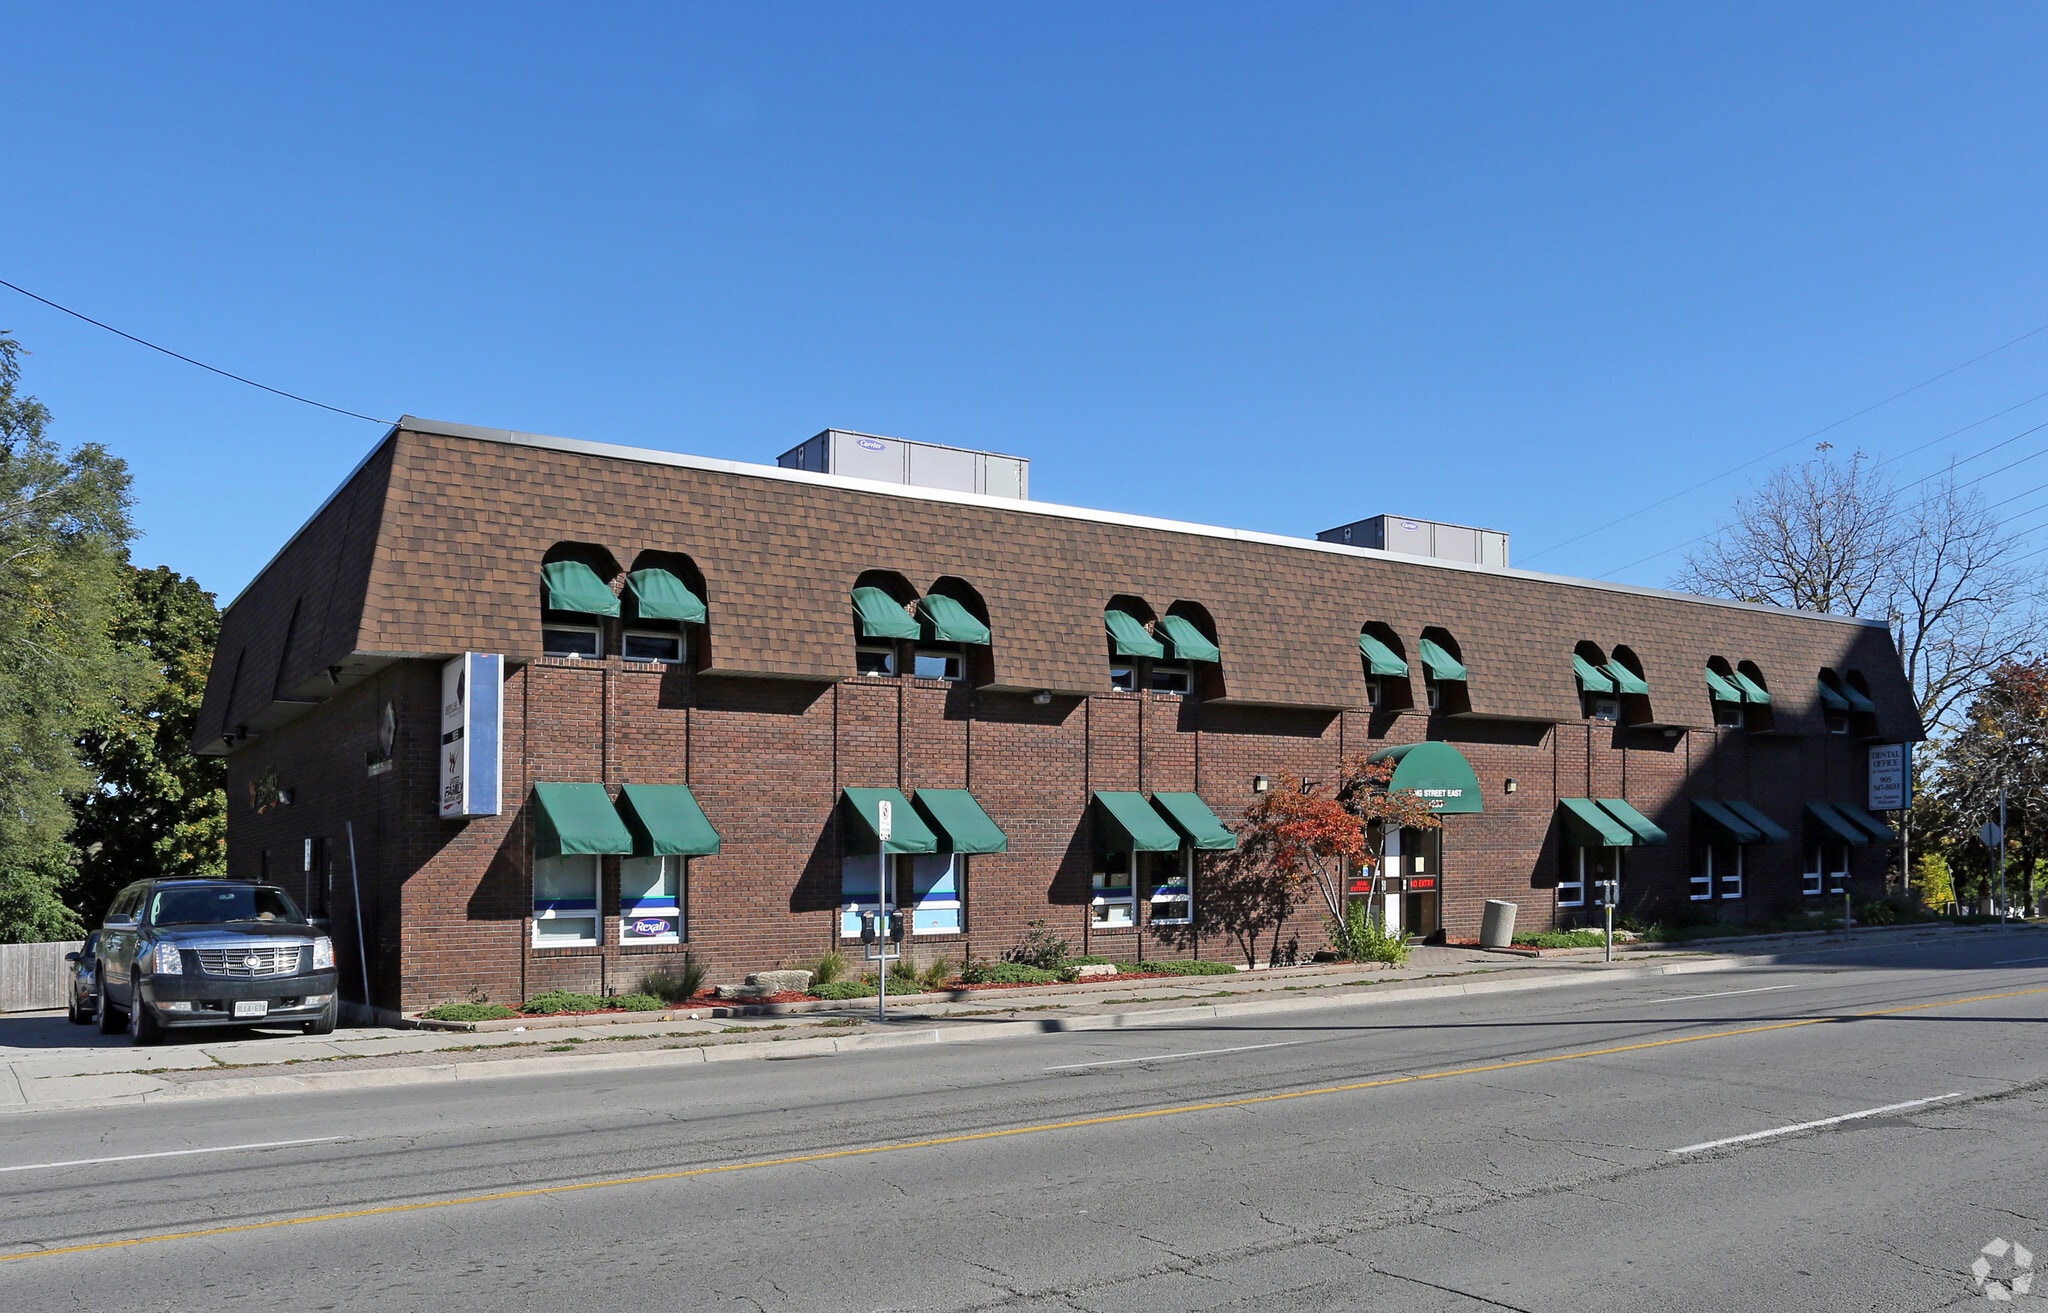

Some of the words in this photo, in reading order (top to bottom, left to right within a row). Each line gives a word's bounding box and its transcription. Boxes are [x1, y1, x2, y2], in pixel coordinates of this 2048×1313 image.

[860, 440, 881, 449] Carrier
[1872, 751, 1899, 759] DENTAL
[1873, 759, 1898, 768] OFFICE
[1880, 775, 1892, 783] 905
[1408, 789, 1423, 798] NG
[1424, 789, 1446, 798] STREET
[1447, 789, 1462, 798] EAST
[1419, 879, 1434, 888] ENTRY
[635, 921, 665, 933] Rexall
